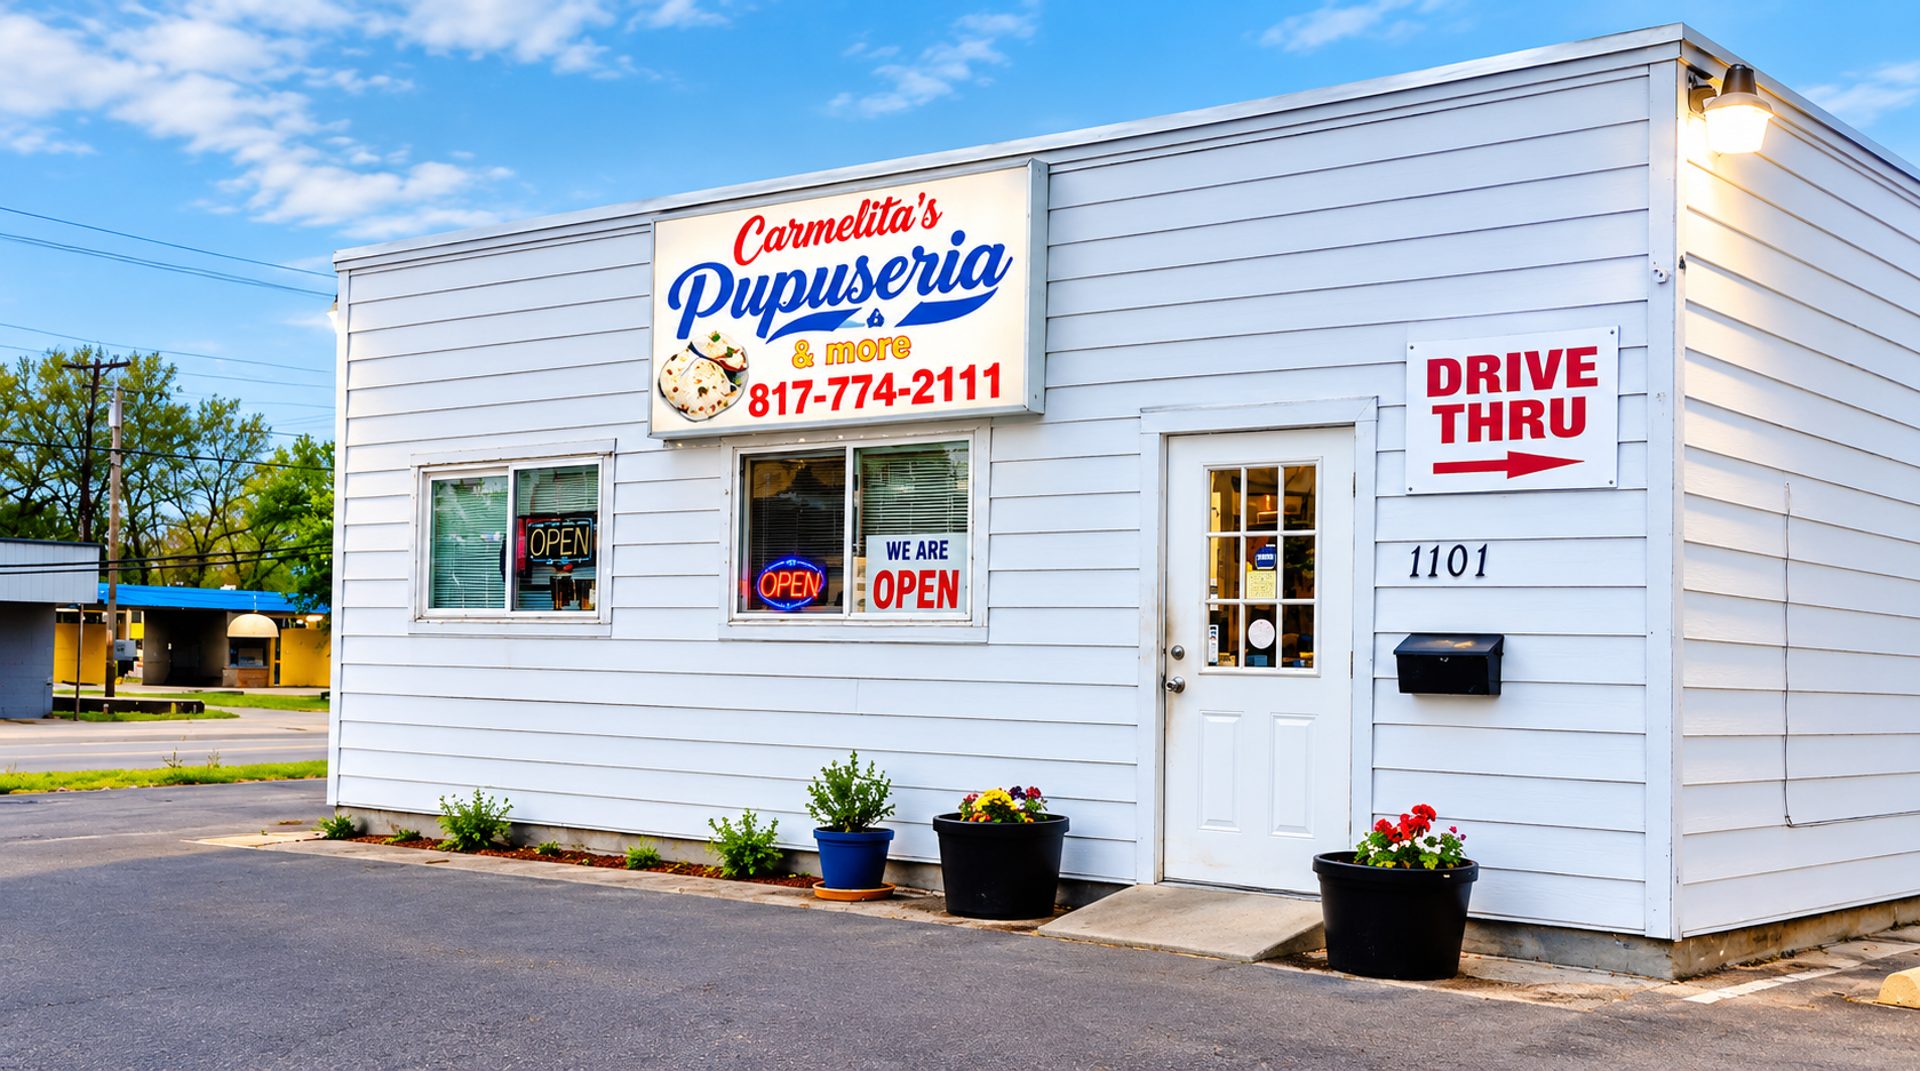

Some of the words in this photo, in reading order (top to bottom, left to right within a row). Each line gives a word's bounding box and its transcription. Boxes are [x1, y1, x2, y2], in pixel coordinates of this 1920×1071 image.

[734, 192, 942, 266] Carmelita's
[667, 229, 1013, 340] Pupuseria
[791, 339, 814, 369] &
[825, 335, 912, 366] more
[1427, 346, 1598, 397] DRIVE
[748, 362, 1001, 418] 817-774-2111
[1431, 396, 1586, 444] THRU
[530, 527, 589, 556] OPEN
[886, 541, 911, 561] WE
[915, 540, 949, 560] ARE
[1409, 543, 1488, 577] 1101
[760, 571, 820, 597] OPEN
[873, 569, 960, 610] OPEN
